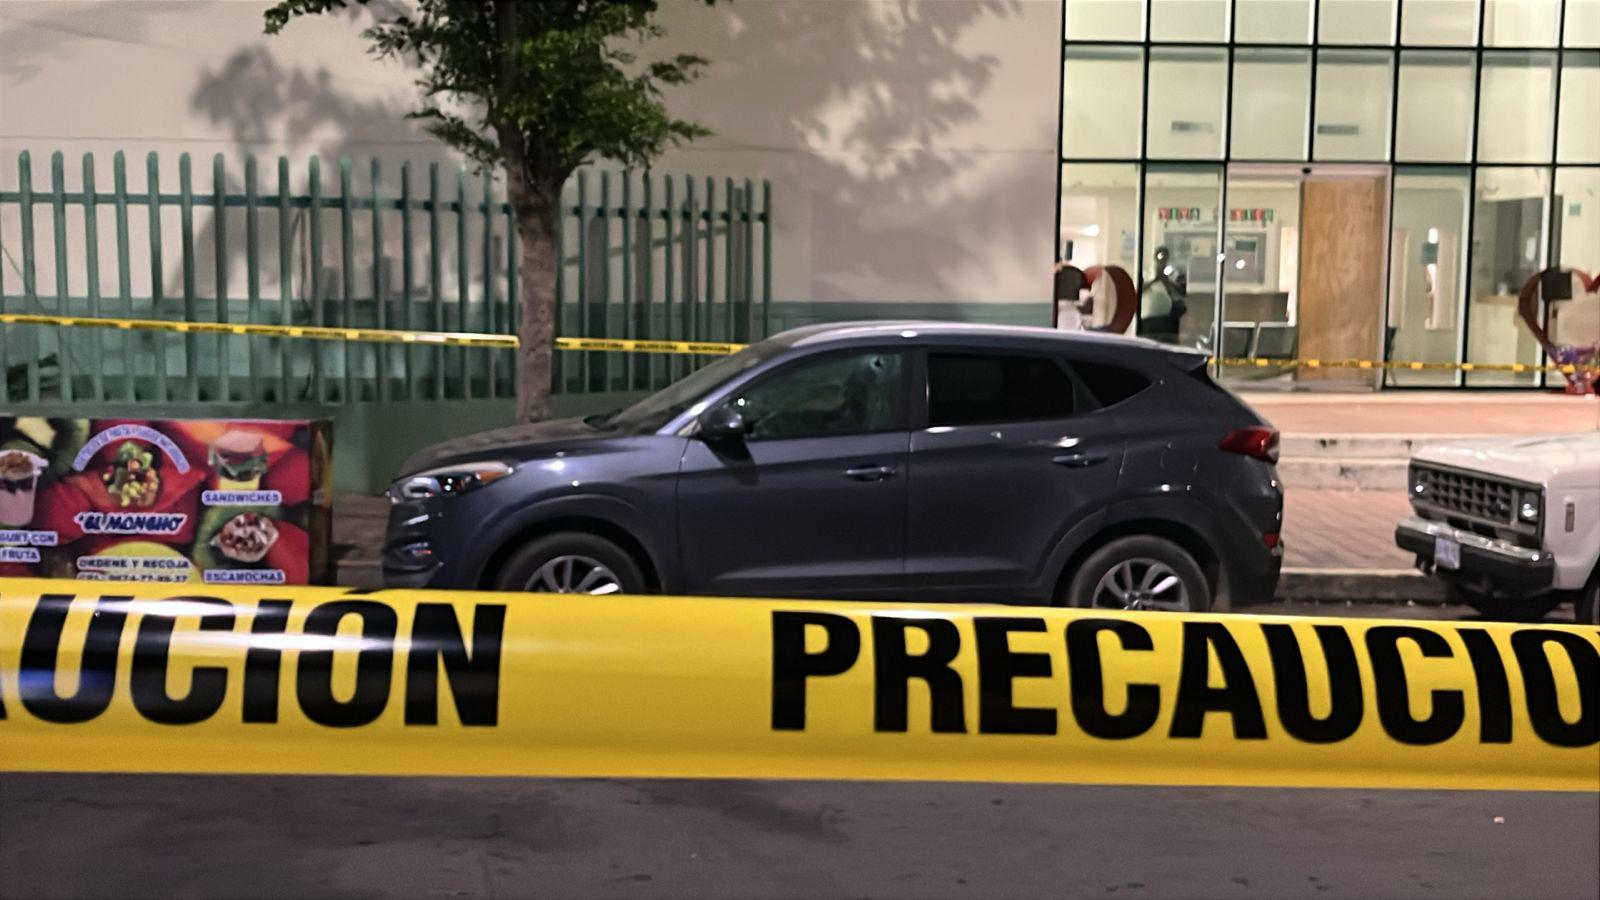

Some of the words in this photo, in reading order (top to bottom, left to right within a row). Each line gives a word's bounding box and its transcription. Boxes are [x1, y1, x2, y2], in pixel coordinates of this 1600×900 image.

[205, 493, 279, 503] SANDWICHES
[79, 559, 127, 568] ORDENE
[206, 572, 283, 582] ESCAMOCHAS
[0, 588, 507, 726] UCIÓN
[771, 611, 1600, 748] PRECAUCIO
